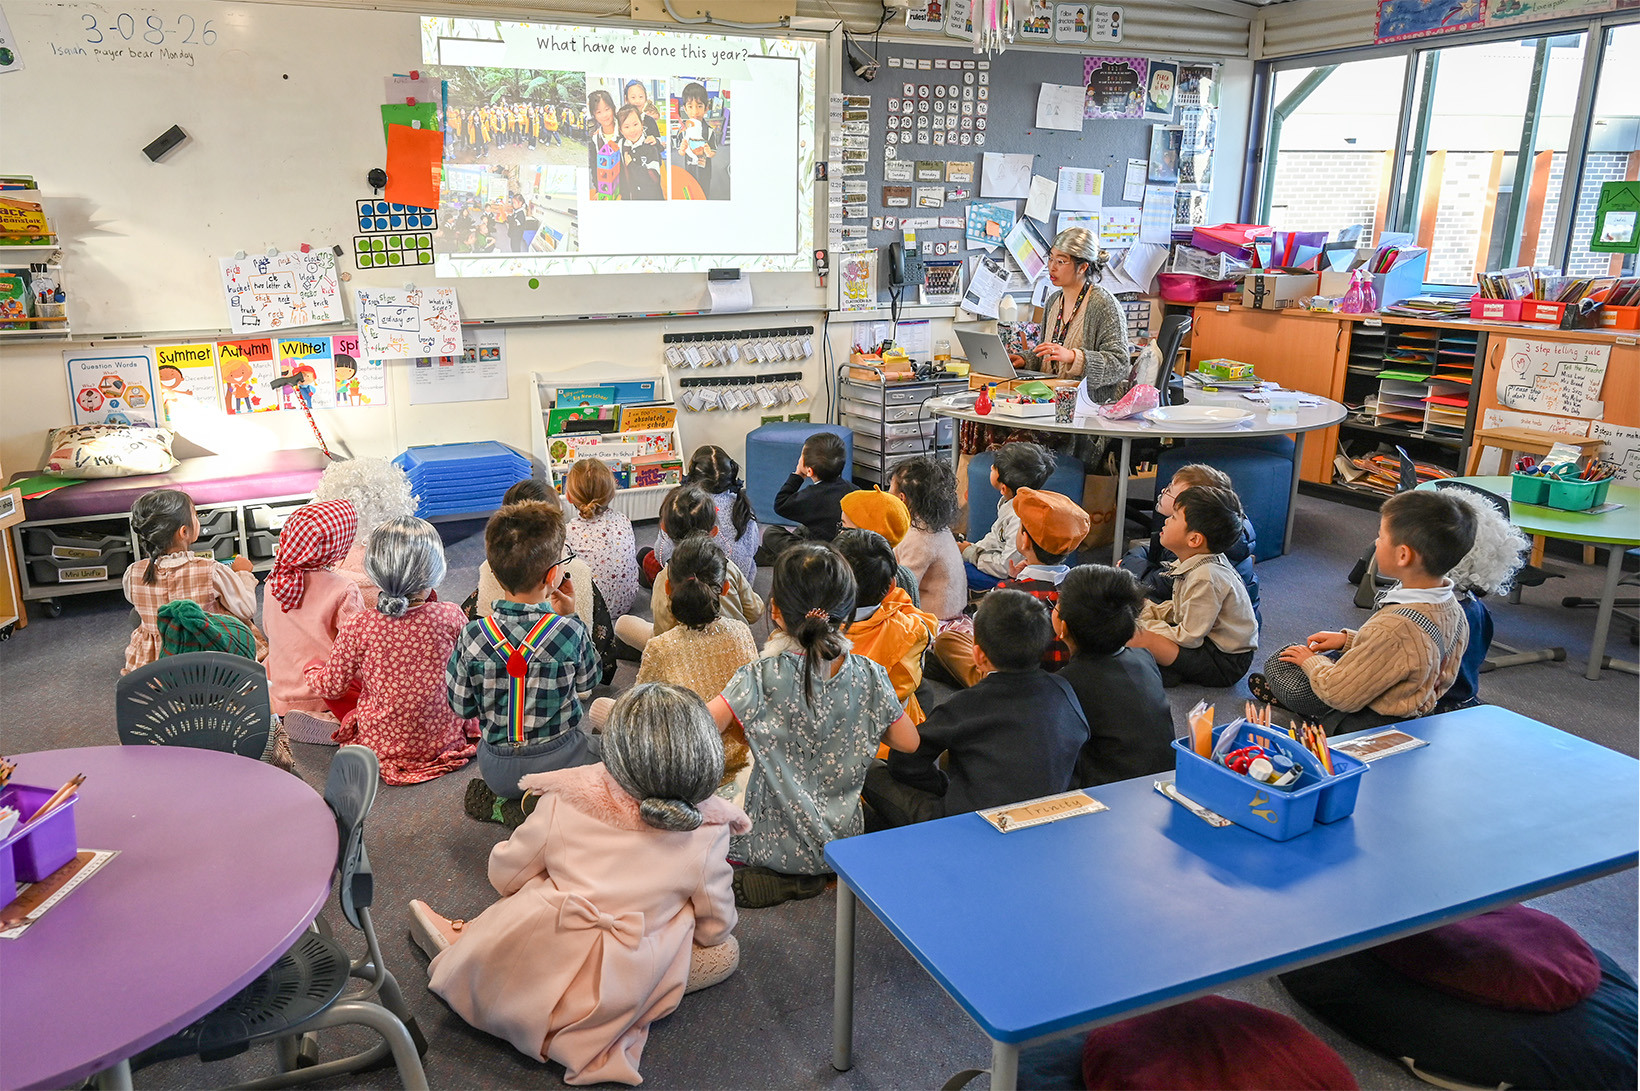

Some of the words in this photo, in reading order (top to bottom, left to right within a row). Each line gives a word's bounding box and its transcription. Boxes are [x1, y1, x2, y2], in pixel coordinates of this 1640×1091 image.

[51, 42, 87, 56] Isaiah
[94, 49, 122, 62] prayer
[128, 48, 153, 58] bear
[160, 48, 195, 66] Monday
[536, 35, 577, 52] What
[582, 37, 615, 54] have
[620, 44, 637, 54] we
[642, 41, 676, 57] done
[681, 44, 706, 58] this
[712, 48, 748, 66] year?
[1160, 82, 1170, 91] KIND
[936, 245, 944, 253] th
[304, 254, 321, 263] clock
[226, 265, 241, 276] pick
[268, 273, 278, 282] ck
[227, 283, 250, 294] bucket
[266, 280, 280, 289] letter
[284, 280, 292, 289] ck
[300, 290, 318, 299] gecko
[321, 286, 335, 294] kick
[358, 290, 370, 299] fork
[313, 298, 329, 307] trick
[240, 305, 256, 314] truck
[268, 309, 284, 317] rock
[312, 310, 330, 320] hack
[220, 342, 269, 358] Autumn
[282, 341, 327, 355] Winter
[1525, 343, 1531, 352] 3
[1535, 344, 1551, 356] step
[1554, 345, 1578, 360] telling
[1585, 347, 1601, 356] rule
[160, 348, 211, 364] Summer
[1542, 362, 1549, 372] 2
[1585, 365, 1604, 374] teacher
[1520, 372, 1526, 380] 1
[647, 421, 668, 429] school
[1594, 425, 1600, 433] 3
[1600, 427, 1612, 438] steps
[94, 454, 122, 466] 1989
[1024, 799, 1083, 816] Trinity
